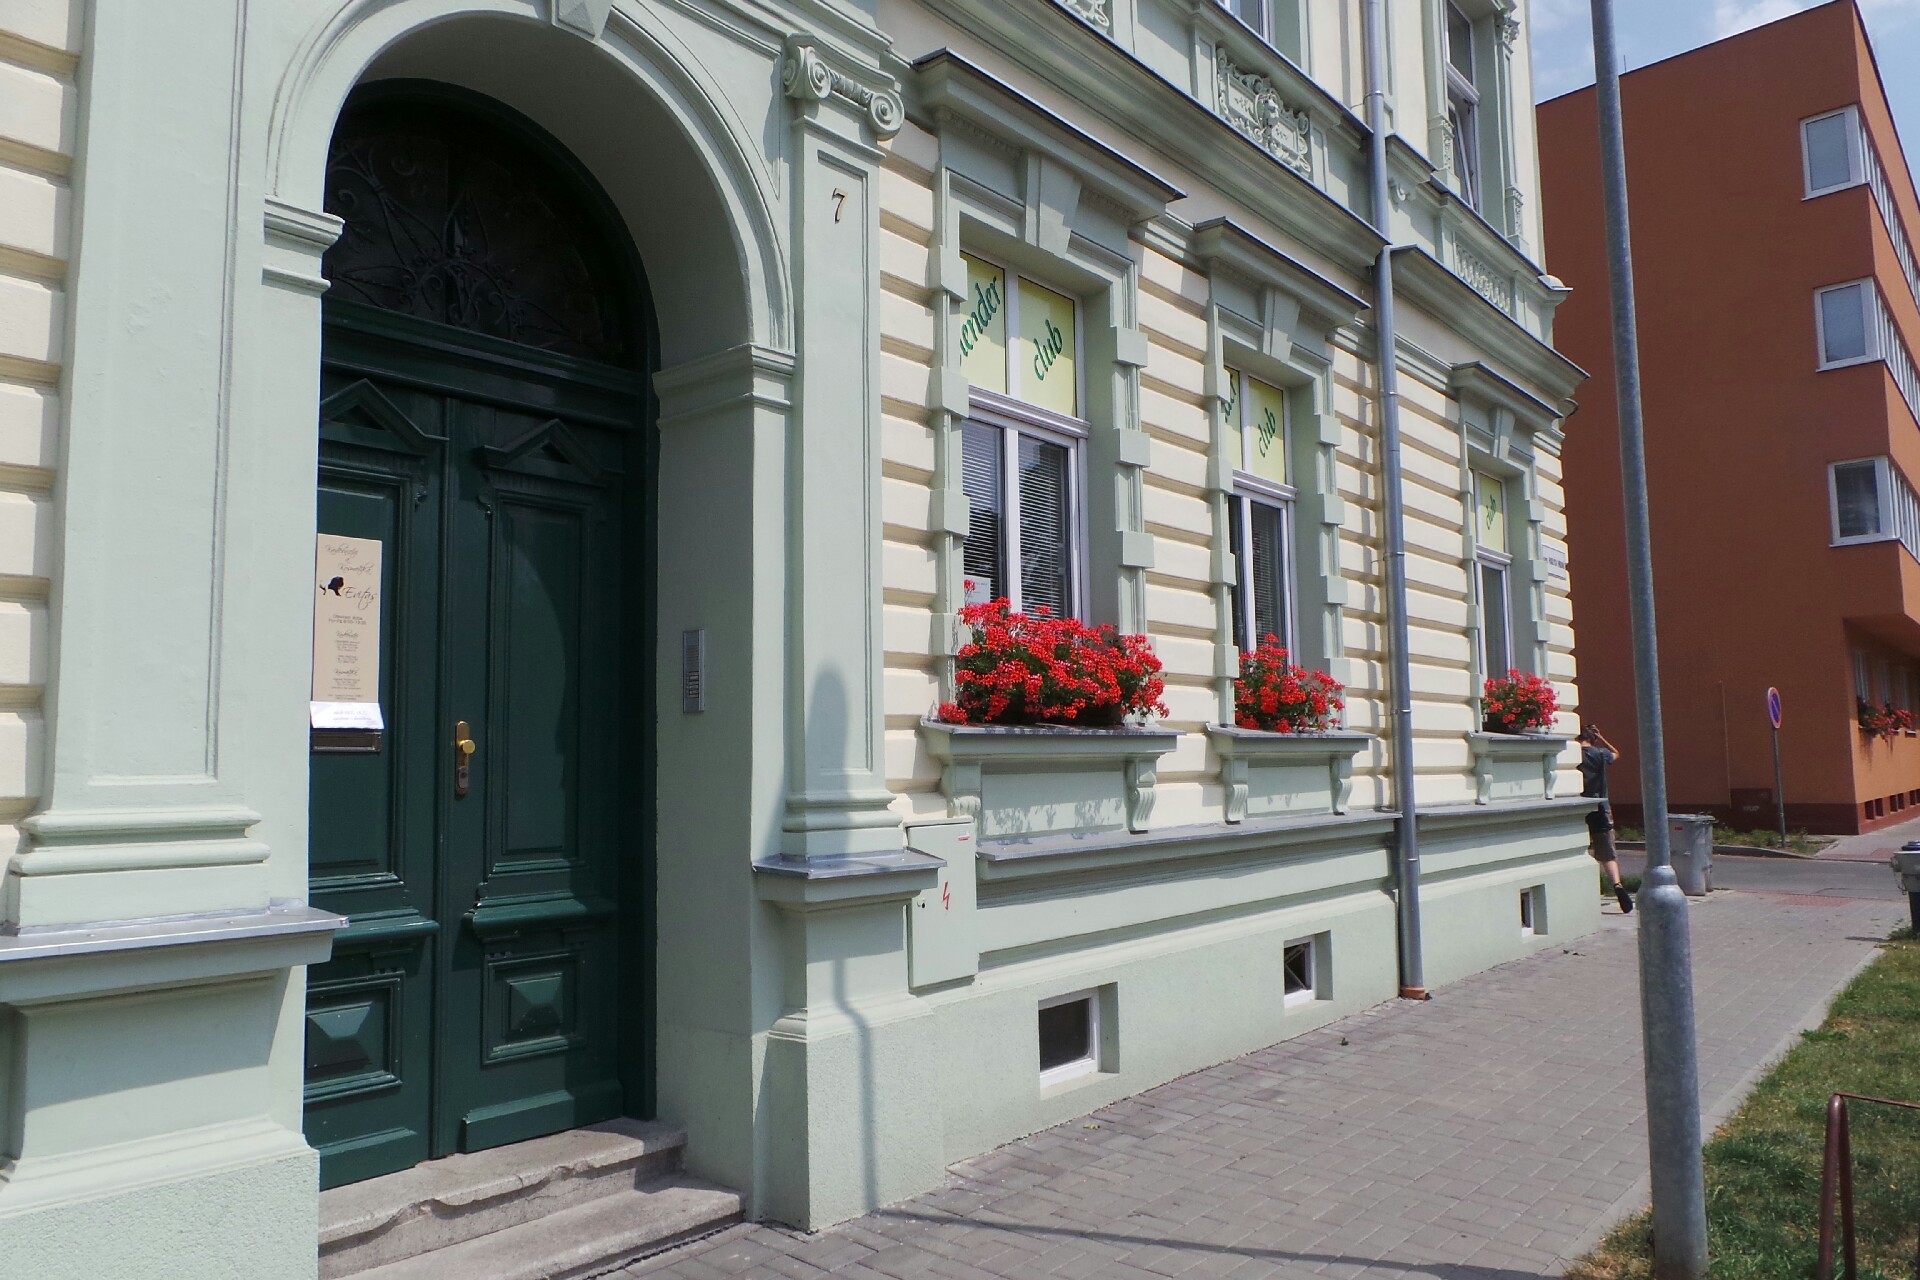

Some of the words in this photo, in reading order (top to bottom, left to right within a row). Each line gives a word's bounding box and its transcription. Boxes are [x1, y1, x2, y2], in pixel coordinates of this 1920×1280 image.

[831, 187, 848, 224] 7
[1033, 319, 1063, 381] club
[1258, 407, 1276, 458] club
